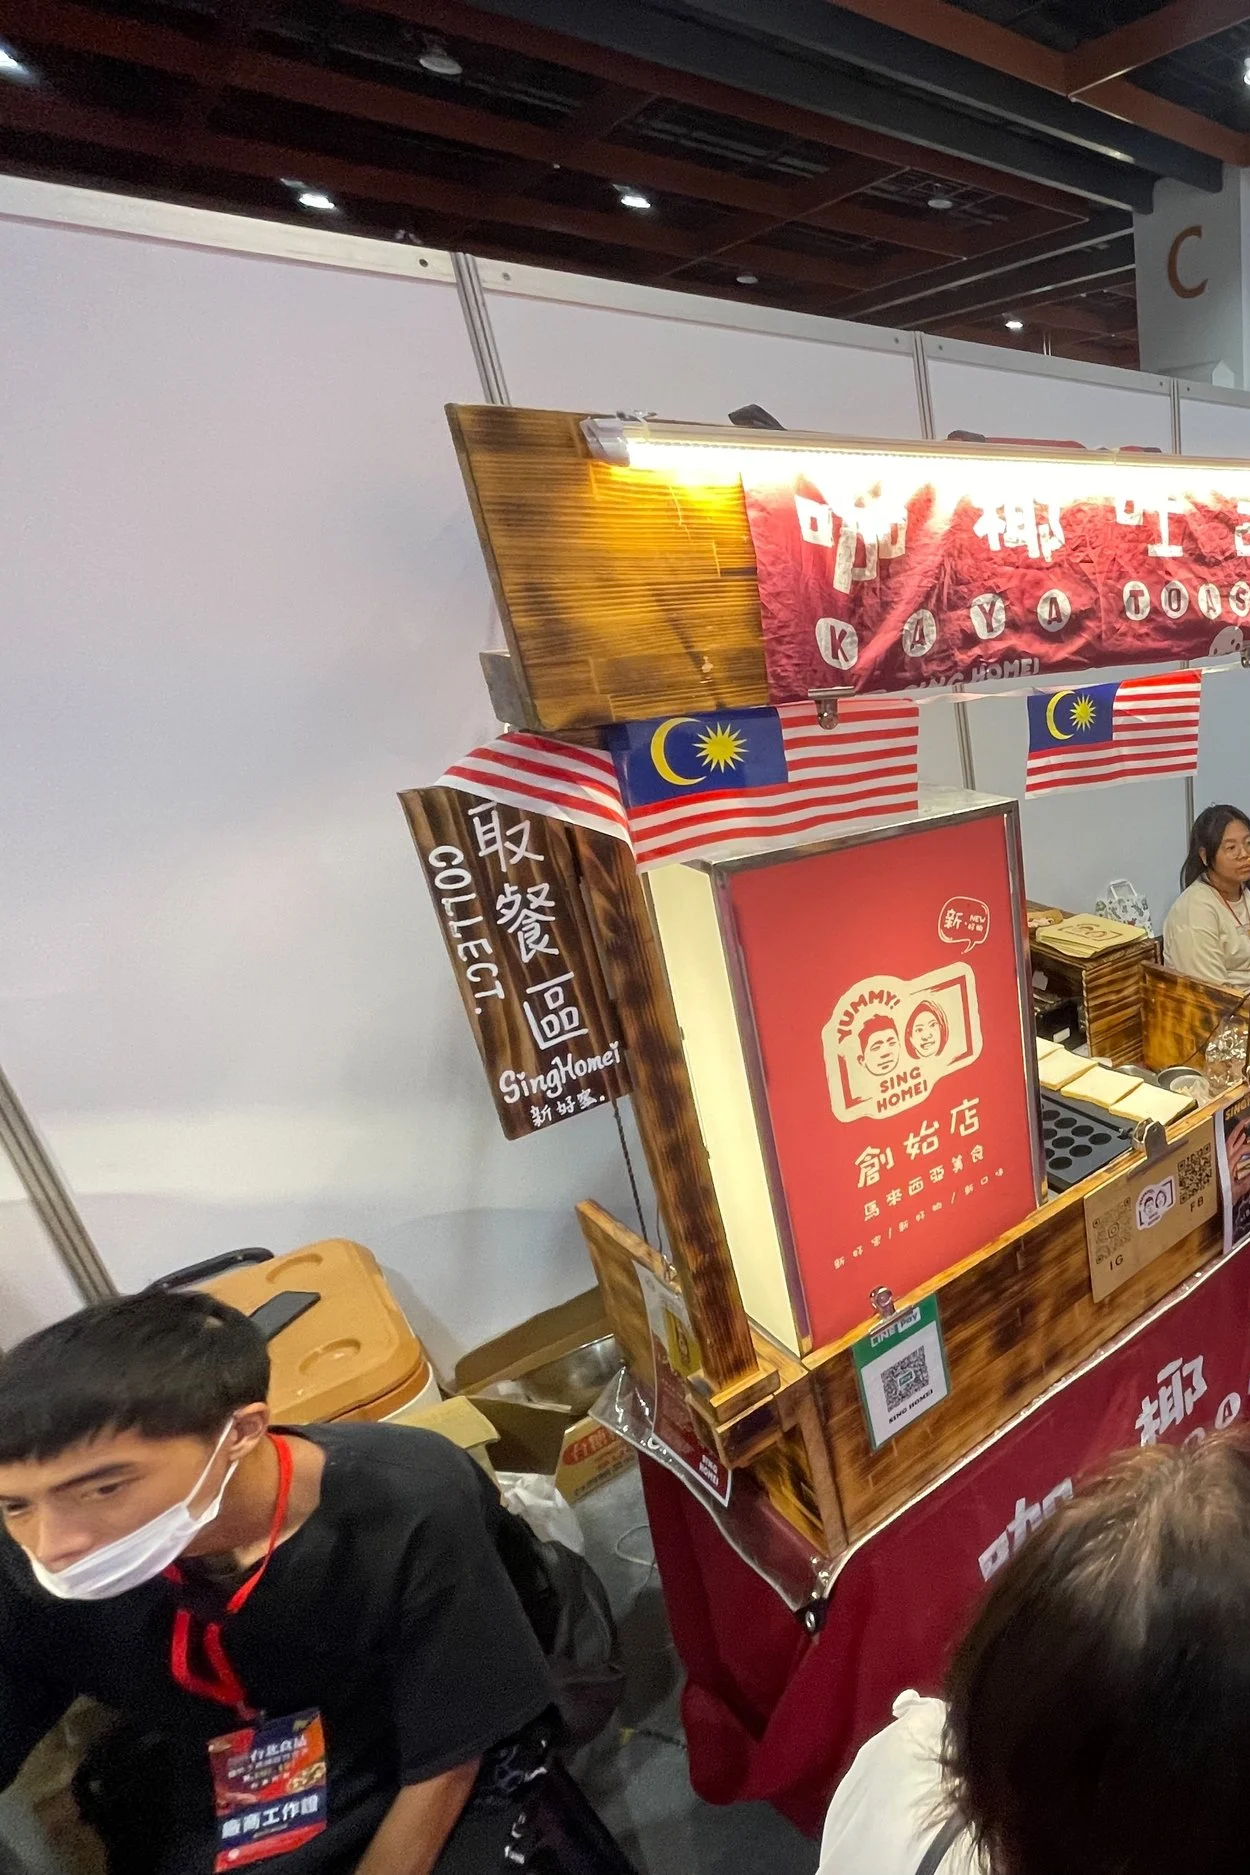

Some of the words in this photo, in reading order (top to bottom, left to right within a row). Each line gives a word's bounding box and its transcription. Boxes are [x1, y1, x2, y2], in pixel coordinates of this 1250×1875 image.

[1166, 224, 1208, 299] C
[826, 594, 1065, 664] KAYA
[428, 845, 506, 1016] COLLECT.
[468, 800, 590, 1051] 取餐區
[836, 989, 901, 1044] YUMMY!
[876, 1079, 928, 1113] HOMEI
[880, 1066, 922, 1094] SING
[854, 1097, 980, 1189] 創始店
[863, 1144, 984, 1222] 馬來西亞美食
[1190, 1196, 1204, 1212] FB
[1109, 1254, 1124, 1271] IG
[908, 1388, 934, 1411] HOMEI
